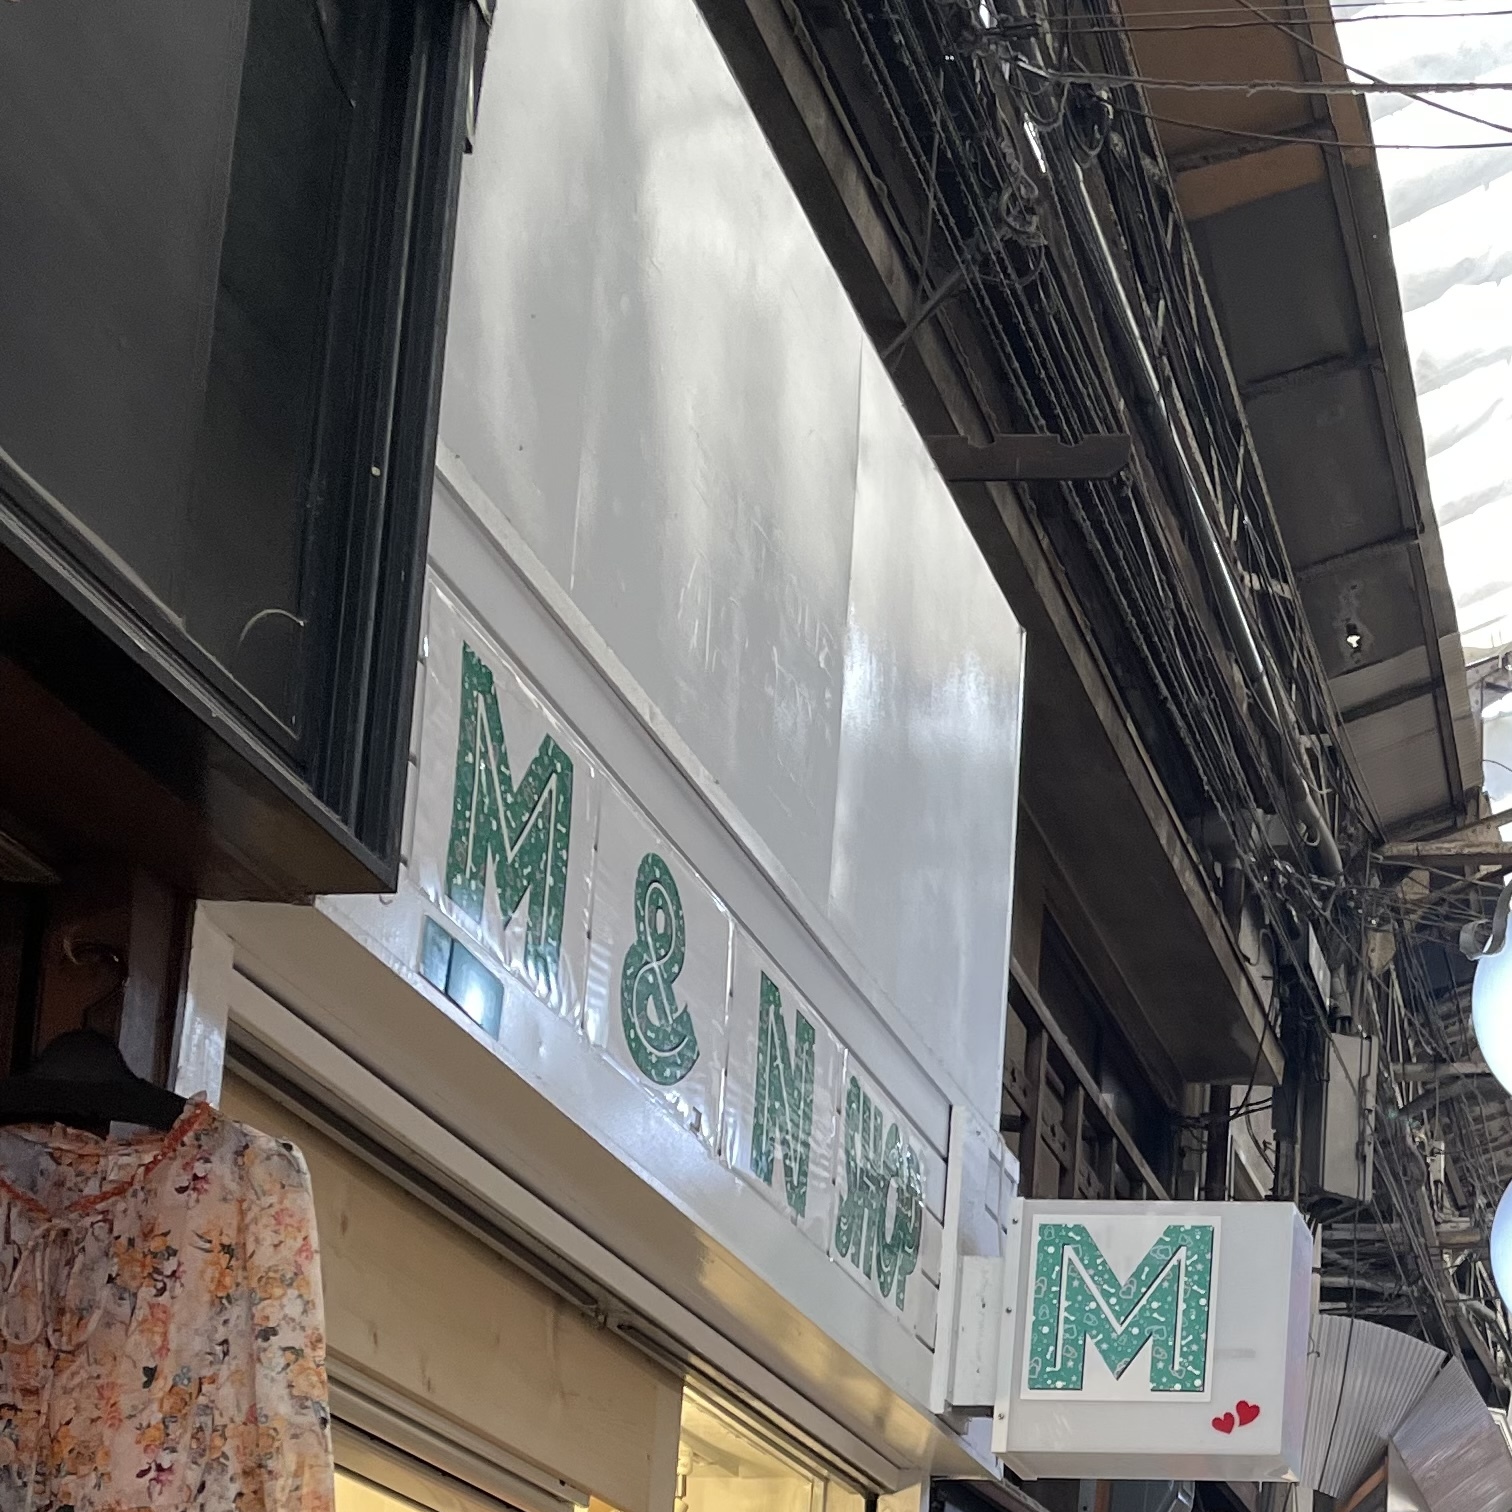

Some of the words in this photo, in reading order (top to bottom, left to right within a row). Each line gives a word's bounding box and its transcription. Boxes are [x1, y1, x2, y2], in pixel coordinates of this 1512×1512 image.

[445, 639, 575, 985] M
[620, 851, 700, 1087] &
[750, 970, 816, 1221] N
[1027, 1223, 1215, 1392] M
